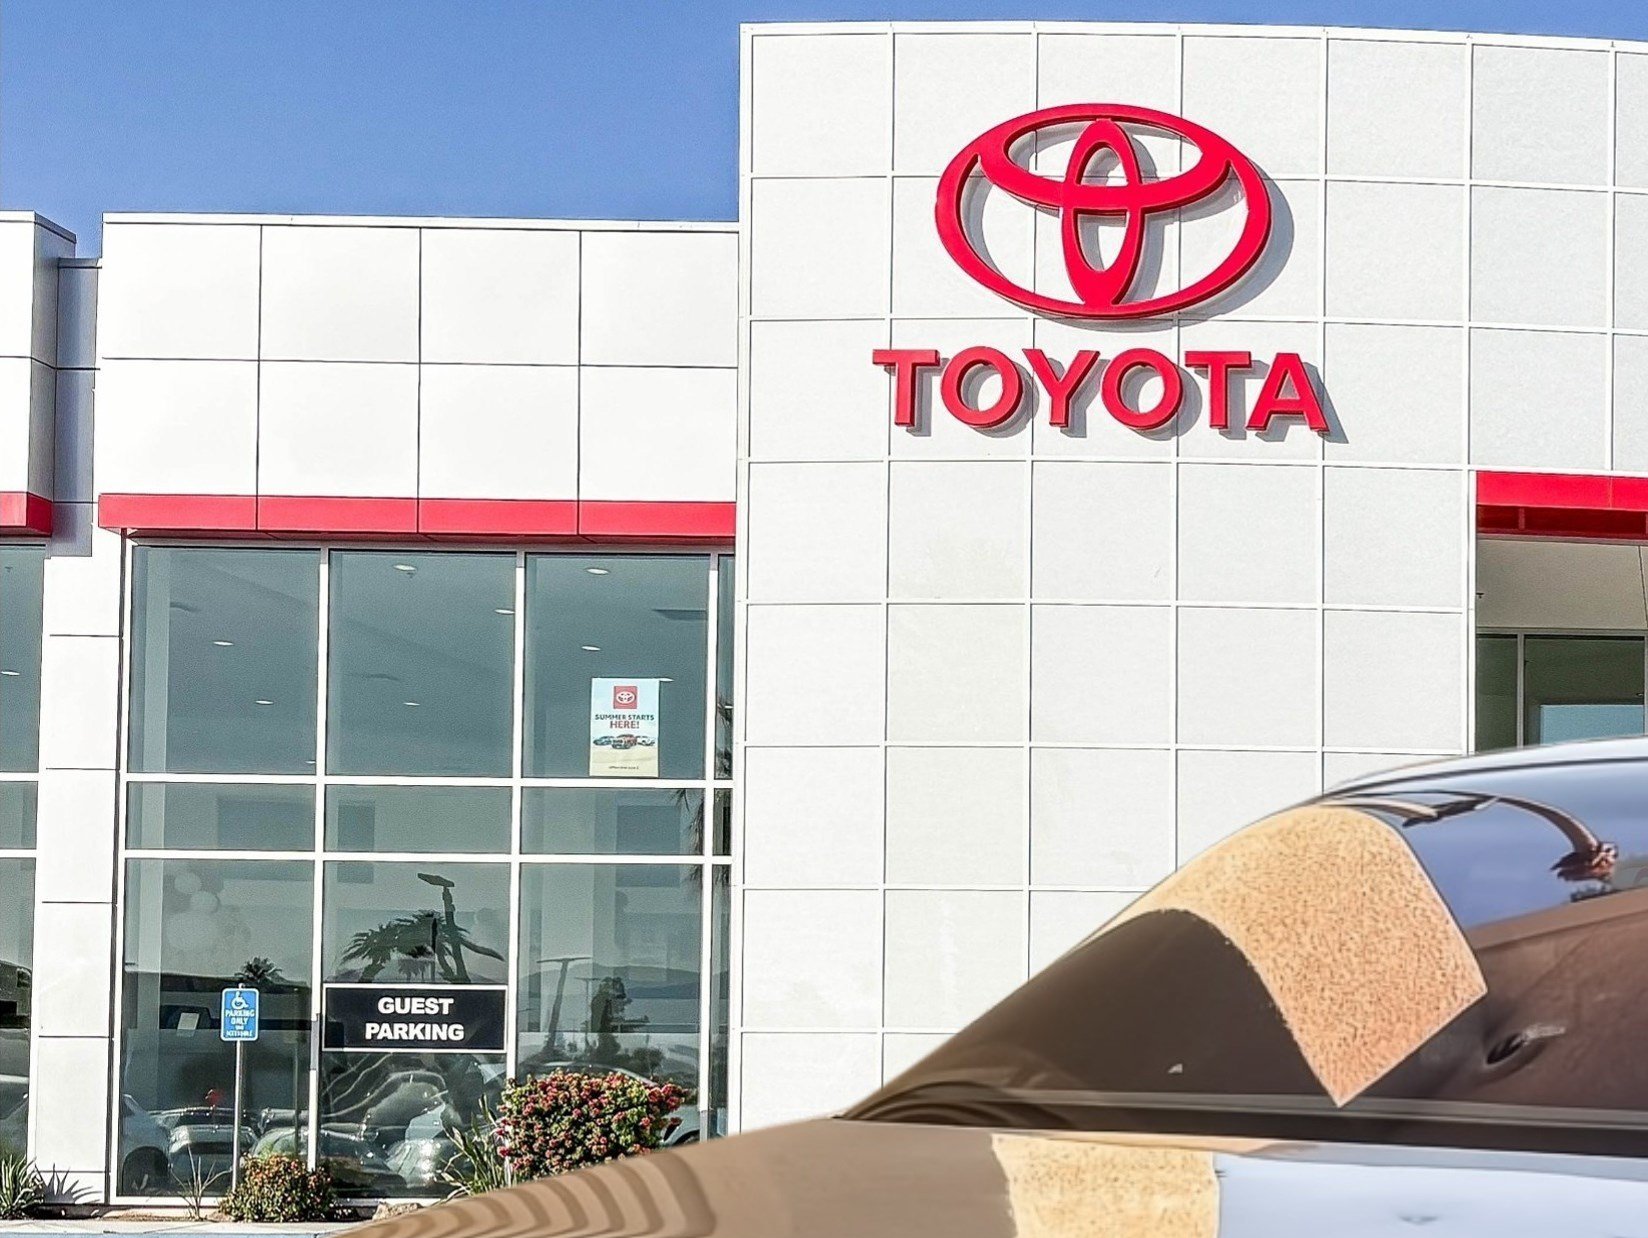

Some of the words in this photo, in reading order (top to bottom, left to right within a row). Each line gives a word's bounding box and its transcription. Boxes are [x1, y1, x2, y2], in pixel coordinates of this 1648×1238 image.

[872, 345, 1330, 434] TOYOTA
[594, 713, 627, 721] SUMMER
[609, 721, 640, 729] HERE!
[377, 997, 455, 1015] GUEST
[365, 1022, 465, 1041] PARKING
